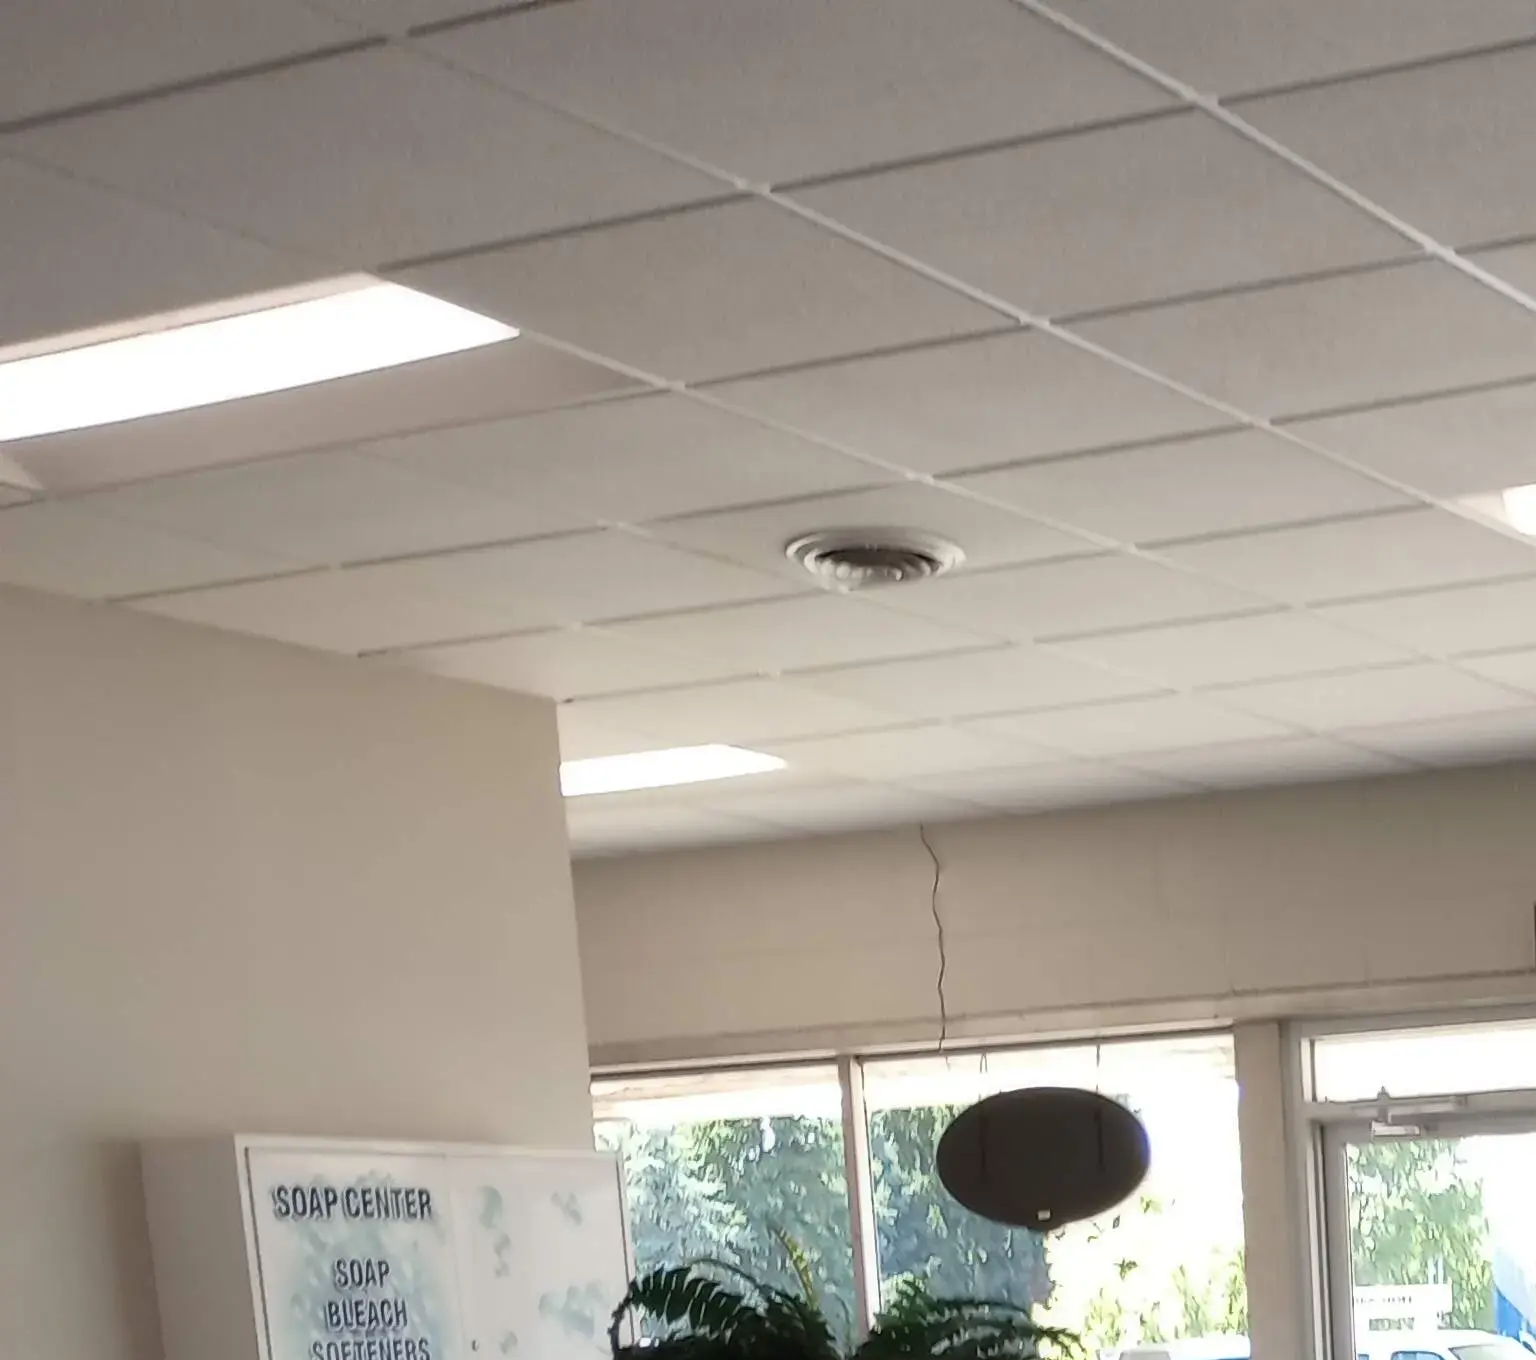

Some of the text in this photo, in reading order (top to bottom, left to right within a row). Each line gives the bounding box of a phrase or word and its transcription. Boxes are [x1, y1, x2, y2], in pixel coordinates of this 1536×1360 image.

[274, 1184, 432, 1219] SOAP CENTER
[335, 1258, 390, 1288] SOAP
[326, 1298, 408, 1328] BLEACH
